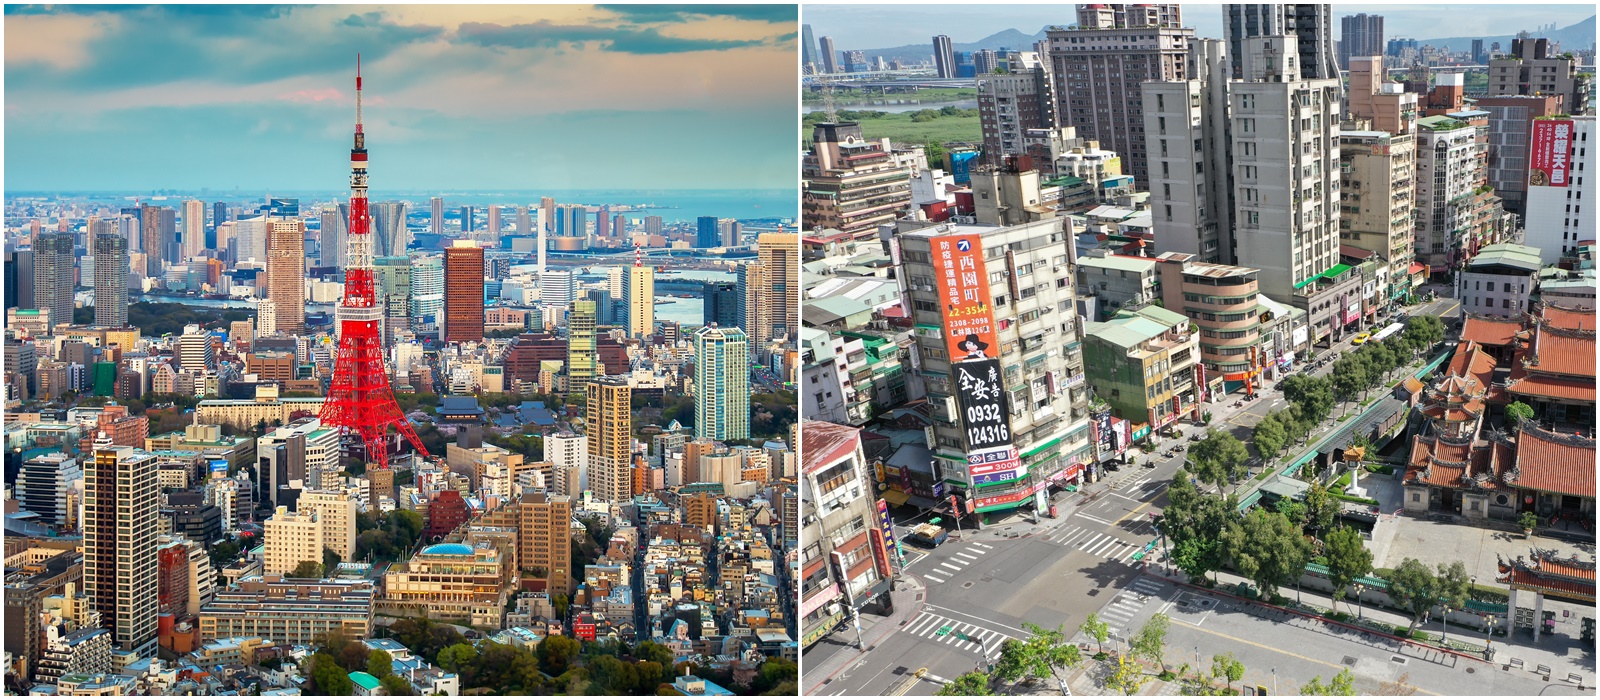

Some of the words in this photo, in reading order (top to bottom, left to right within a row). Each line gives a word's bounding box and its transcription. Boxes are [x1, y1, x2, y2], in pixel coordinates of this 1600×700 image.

[1551, 123, 1570, 183] 榮耀天邑
[939, 241, 961, 305] 防疫捷運精品宅
[958, 254, 980, 303] 西園町
[949, 317, 989, 328] 2308-2098
[958, 367, 990, 400] 全安
[987, 366, 1001, 398] 廣告
[967, 403, 1000, 424] 0932
[968, 424, 1008, 446] 124316
[995, 461, 1019, 470] 300M
